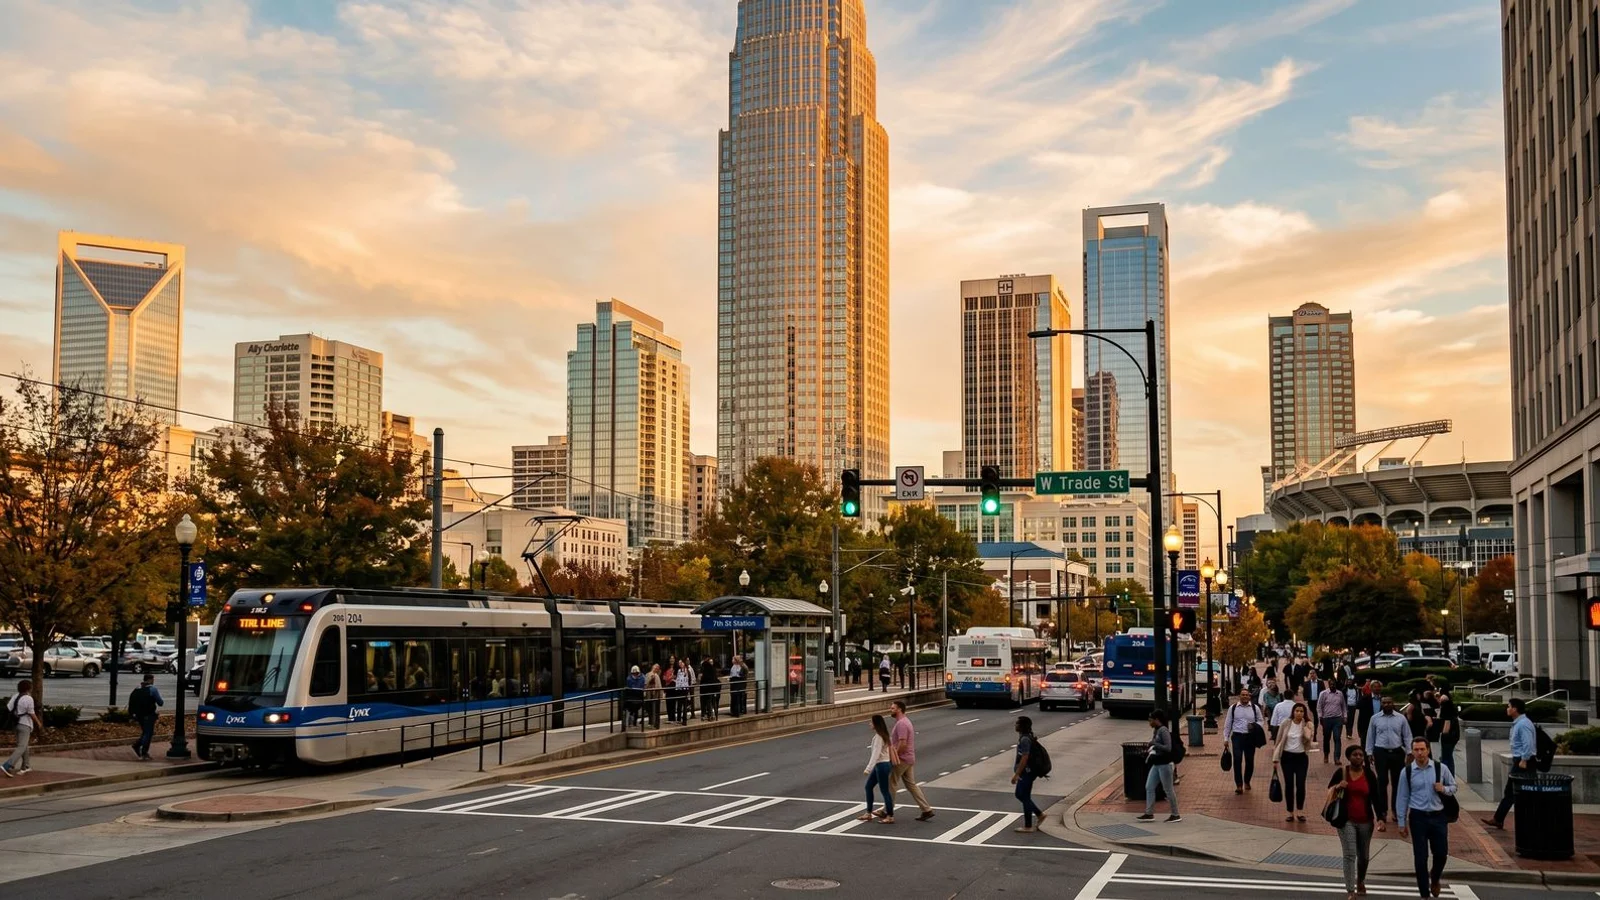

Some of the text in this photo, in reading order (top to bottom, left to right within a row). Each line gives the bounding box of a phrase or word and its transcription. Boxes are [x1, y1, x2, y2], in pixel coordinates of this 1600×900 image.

[1040, 475, 1124, 490] W Trade St
[347, 613, 362, 623] 204
[732, 619, 756, 627] Station
